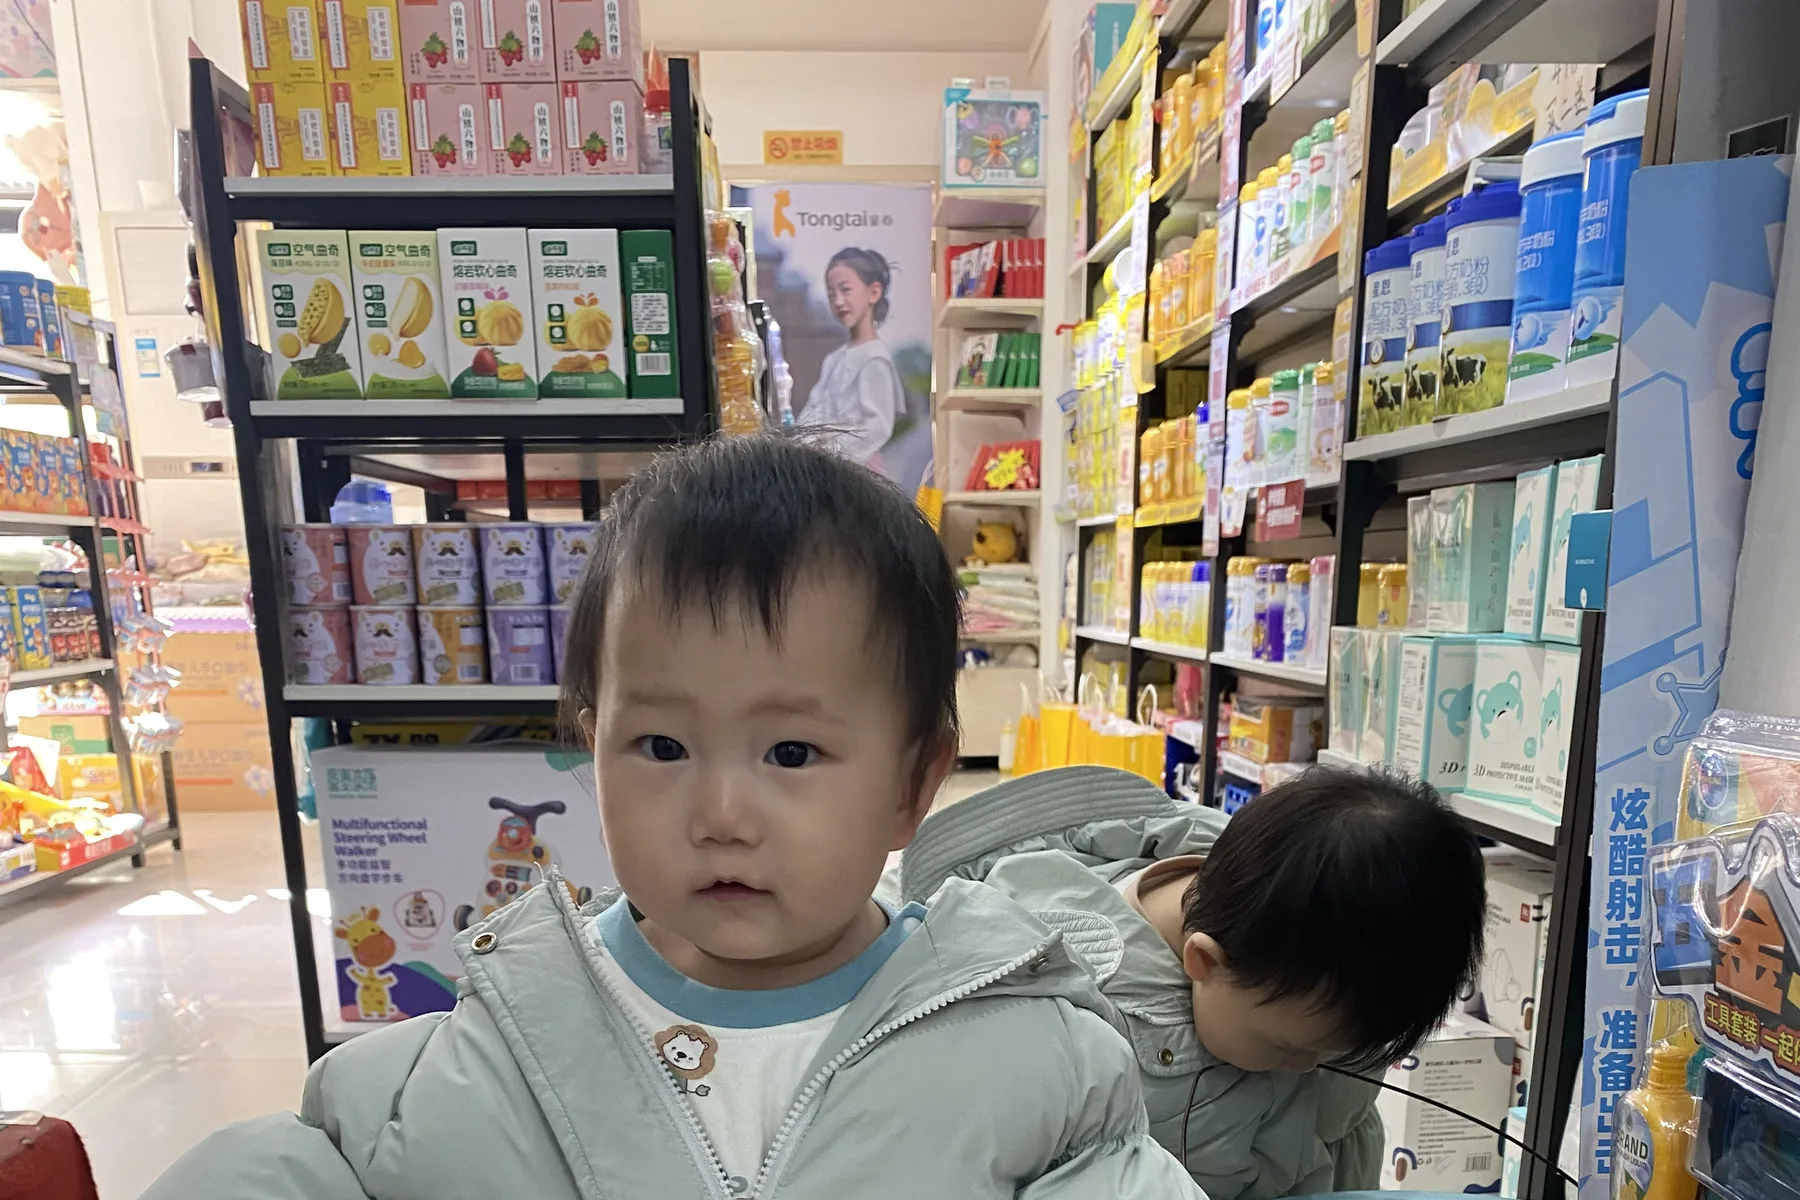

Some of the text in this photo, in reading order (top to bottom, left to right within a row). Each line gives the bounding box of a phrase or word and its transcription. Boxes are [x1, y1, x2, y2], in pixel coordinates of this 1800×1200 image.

[797, 210, 867, 231] Tongtai
[293, 244, 339, 257] 空气曲奇
[385, 245, 431, 257] 空气曲奇
[453, 265, 517, 278] 熔岩软心曲奇
[543, 265, 607, 278] 熔岩软心曲奇
[1439, 762, 1459, 774] 3D
[1473, 764, 1485, 776] 3D
[1486, 768, 1518, 783] PROTECTIVE
[332, 818, 427, 831] Multifunctional
[334, 831, 427, 846] Steering Wheel
[334, 845, 378, 857] Walker
[336, 860, 391, 871] 多功能益智
[337, 873, 403, 884] 方向盘学步车
[1654, 852, 1800, 1016] 五金
[1707, 999, 1757, 1046] 工具套装
